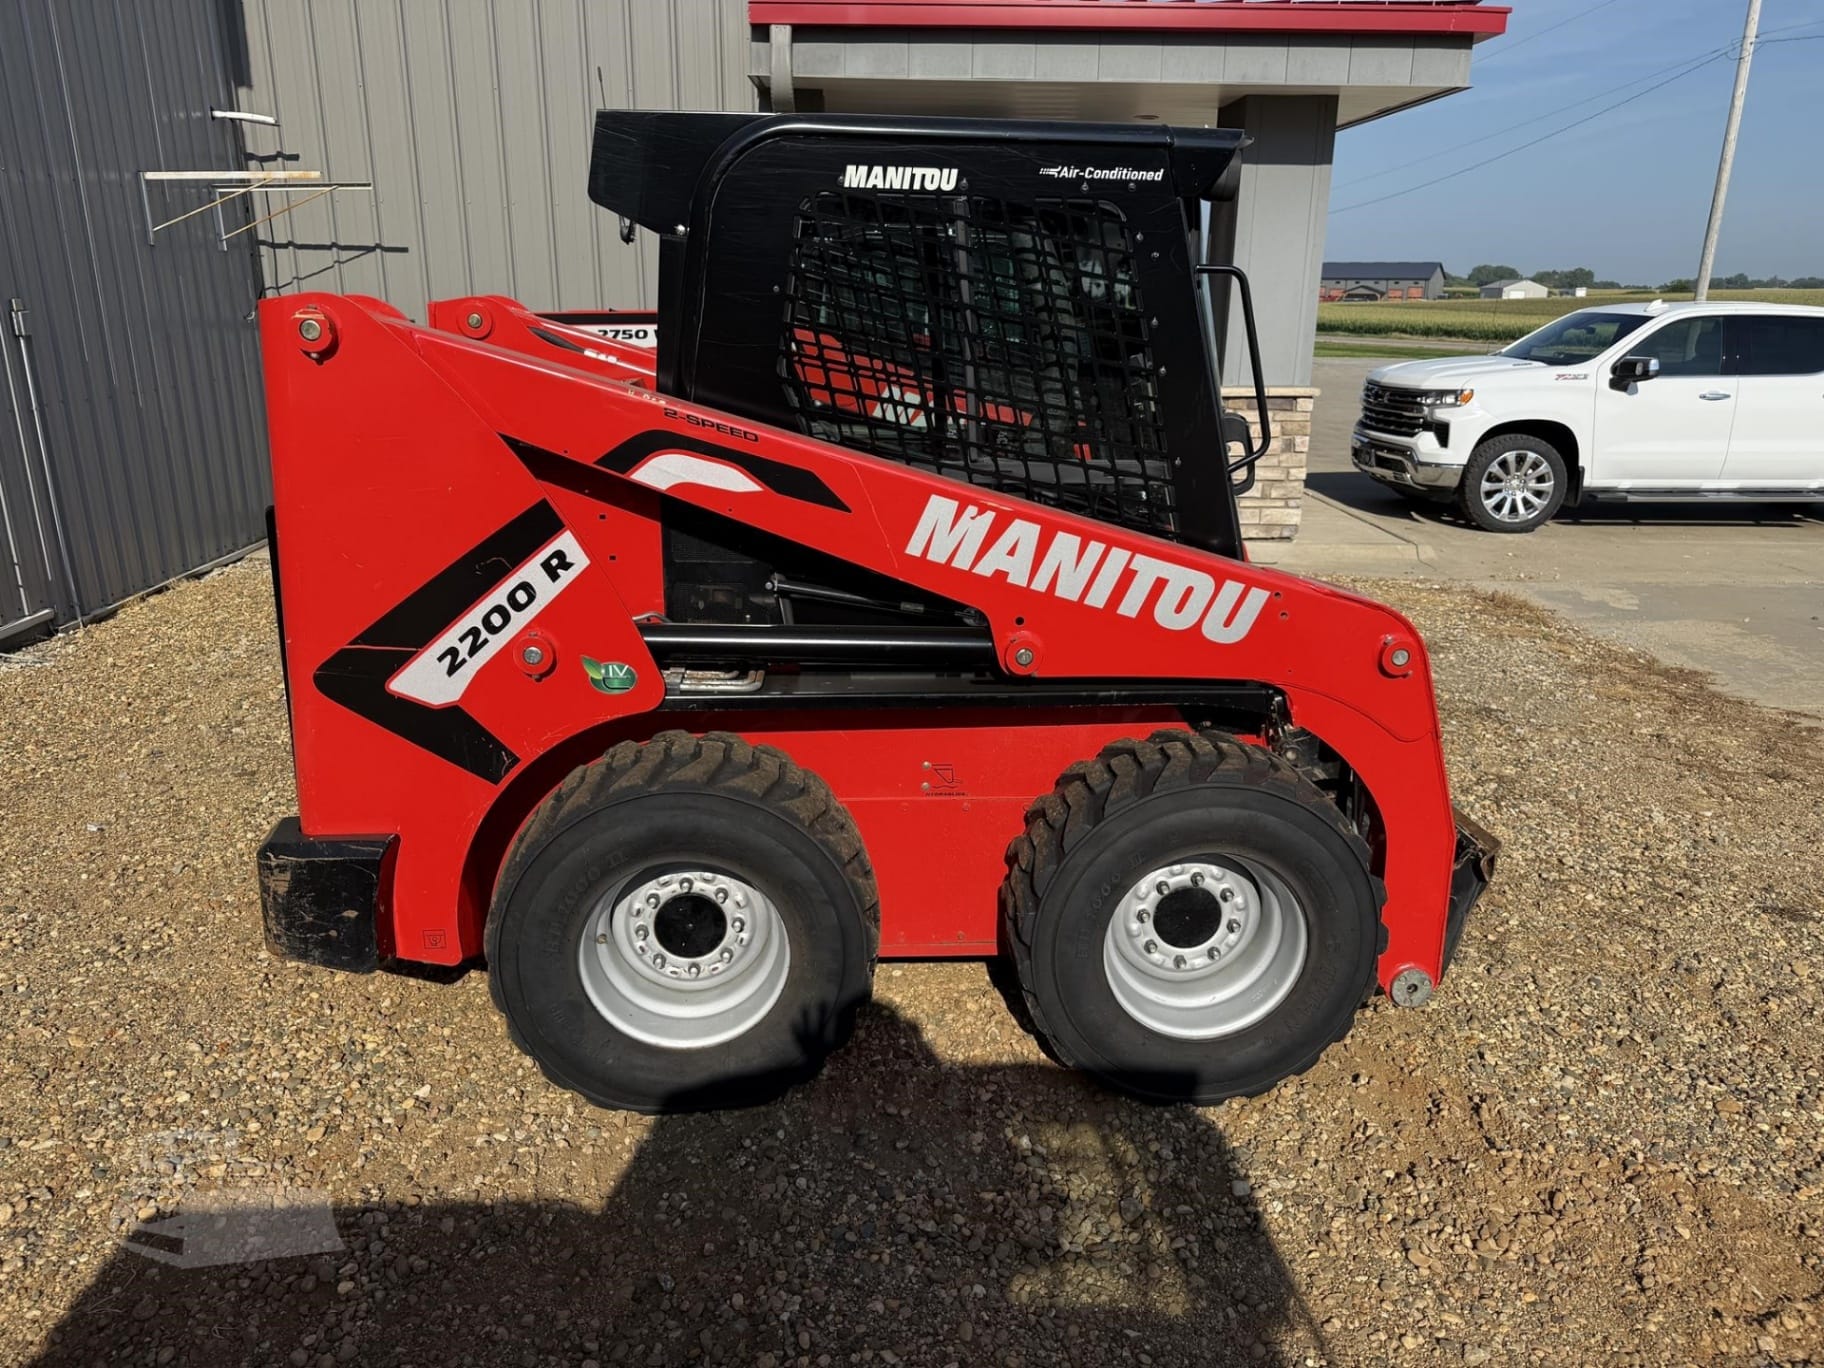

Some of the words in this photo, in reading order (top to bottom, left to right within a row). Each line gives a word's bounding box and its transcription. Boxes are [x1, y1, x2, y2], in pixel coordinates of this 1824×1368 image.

[843, 164, 959, 192] MANITOU
[1058, 165, 1165, 183] Air-Conditioned
[663, 407, 760, 443] 2-SPEED
[904, 493, 1272, 645] MANITOU
[436, 580, 537, 678] 2200
[539, 549, 576, 583] R
[608, 664, 629, 678] IV
